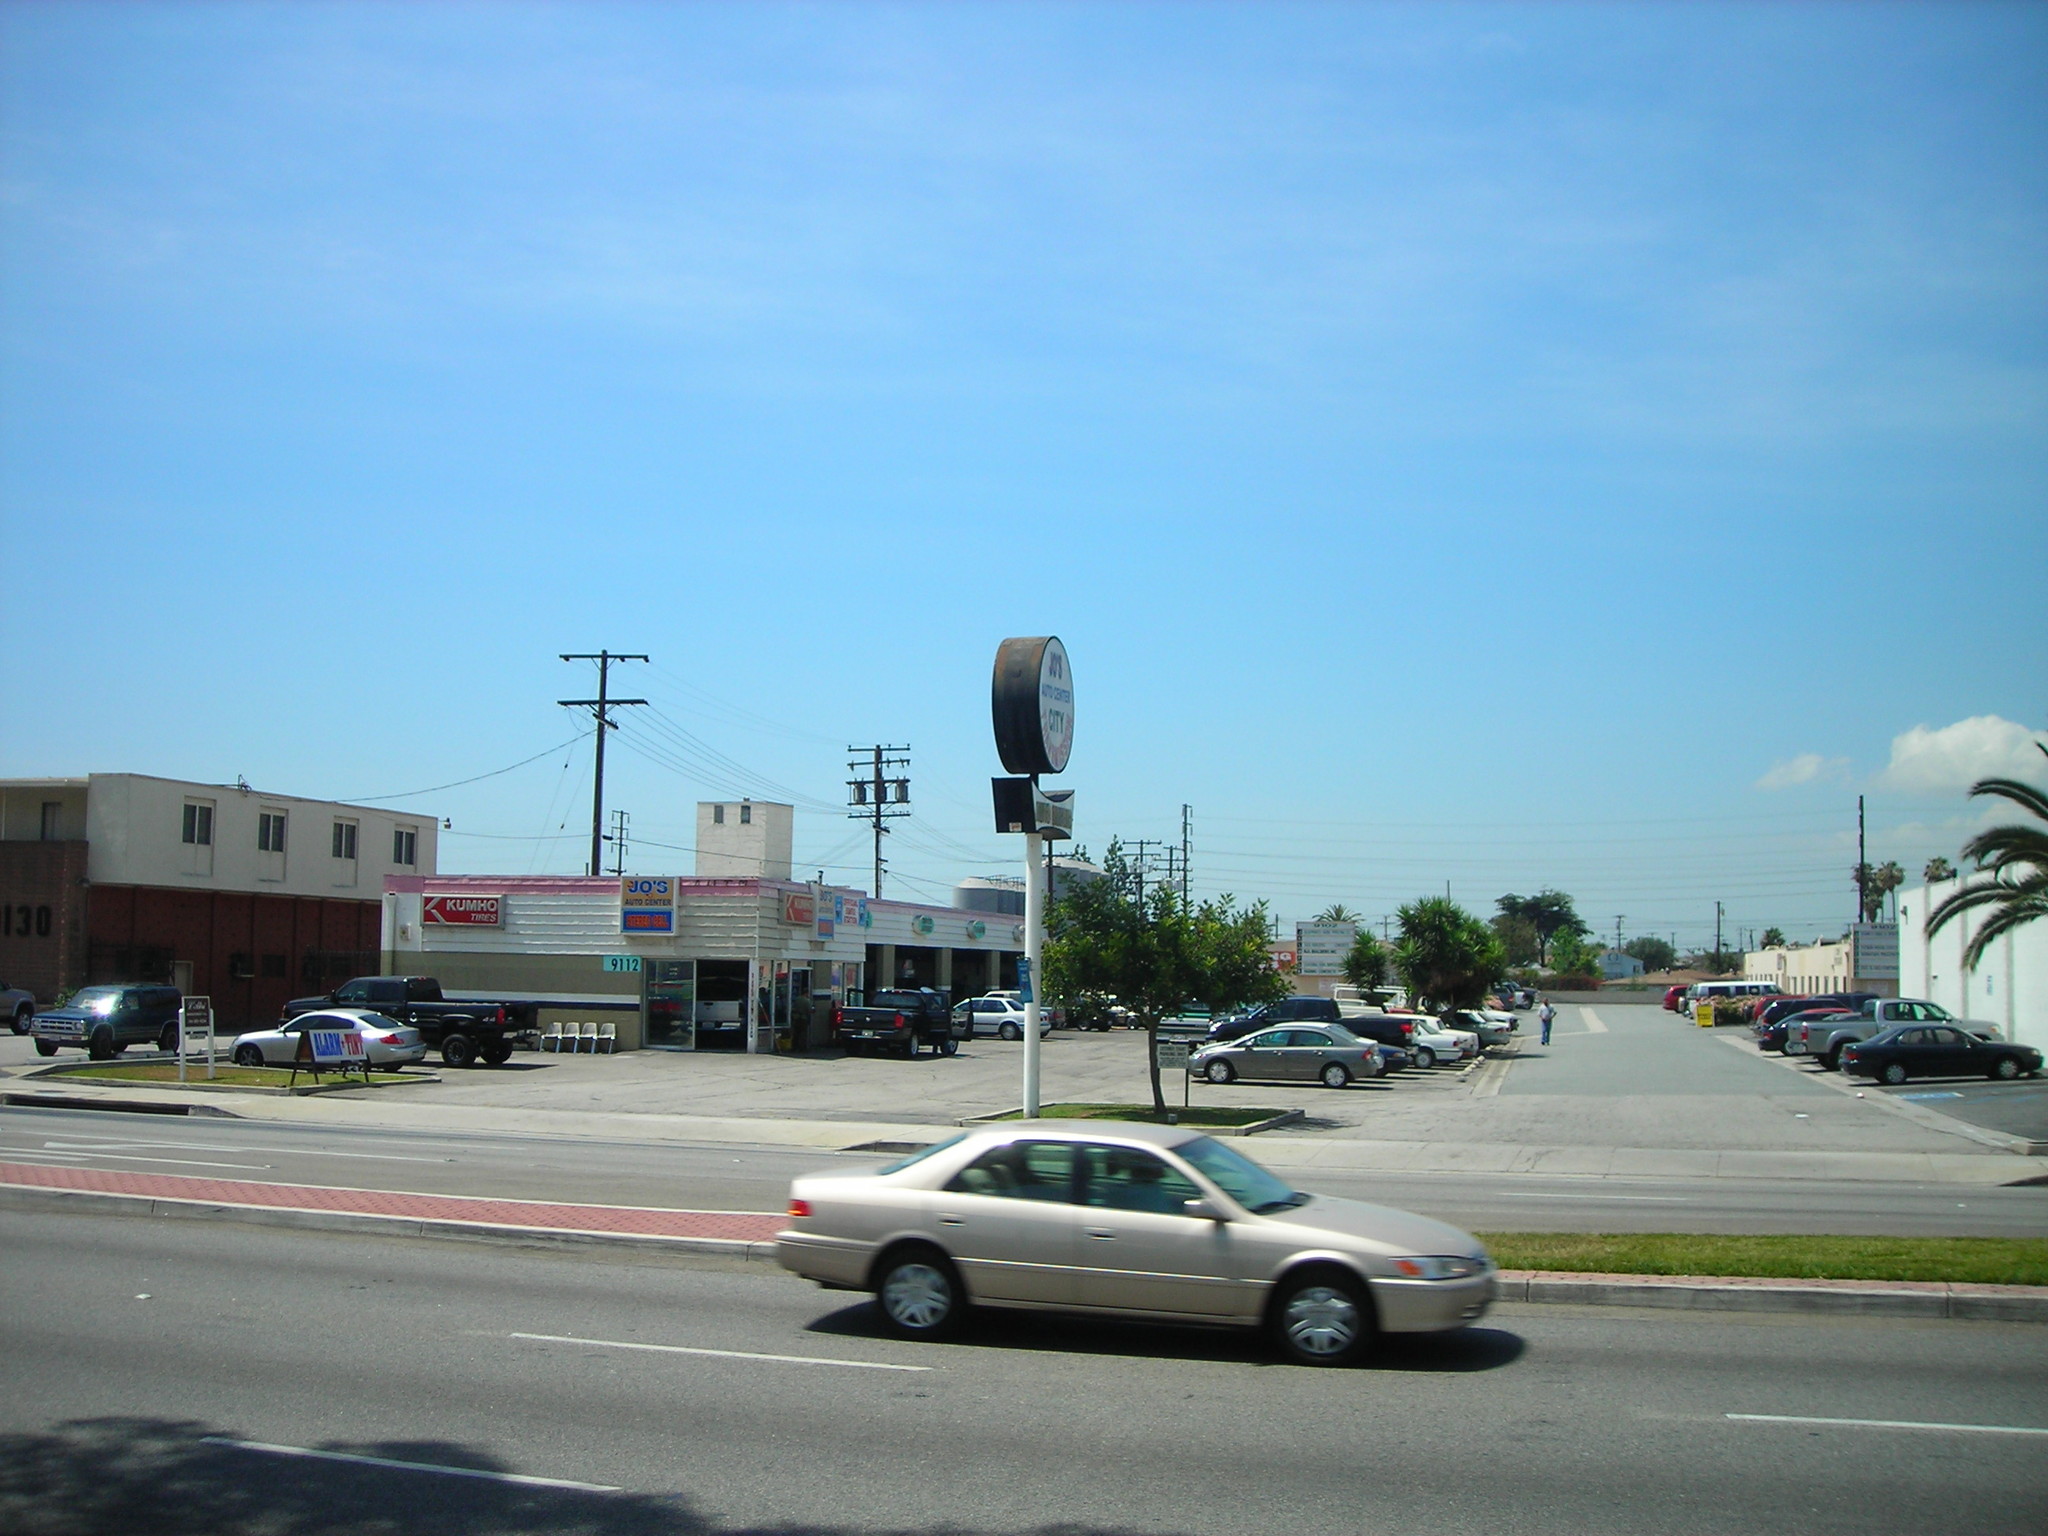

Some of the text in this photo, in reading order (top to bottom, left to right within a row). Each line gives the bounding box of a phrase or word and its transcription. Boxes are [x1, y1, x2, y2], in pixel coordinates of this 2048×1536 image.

[1049, 708, 1064, 734] CITY
[627, 880, 668, 895] JO'S
[446, 899, 497, 911] KUMHO
[625, 898, 672, 906] AUTO CENTER
[0, 904, 52, 937] 130
[471, 913, 497, 923] TIRES
[611, 958, 639, 971] 9112
[313, 1033, 343, 1056] ALARM
[344, 1033, 364, 1055] TINT
